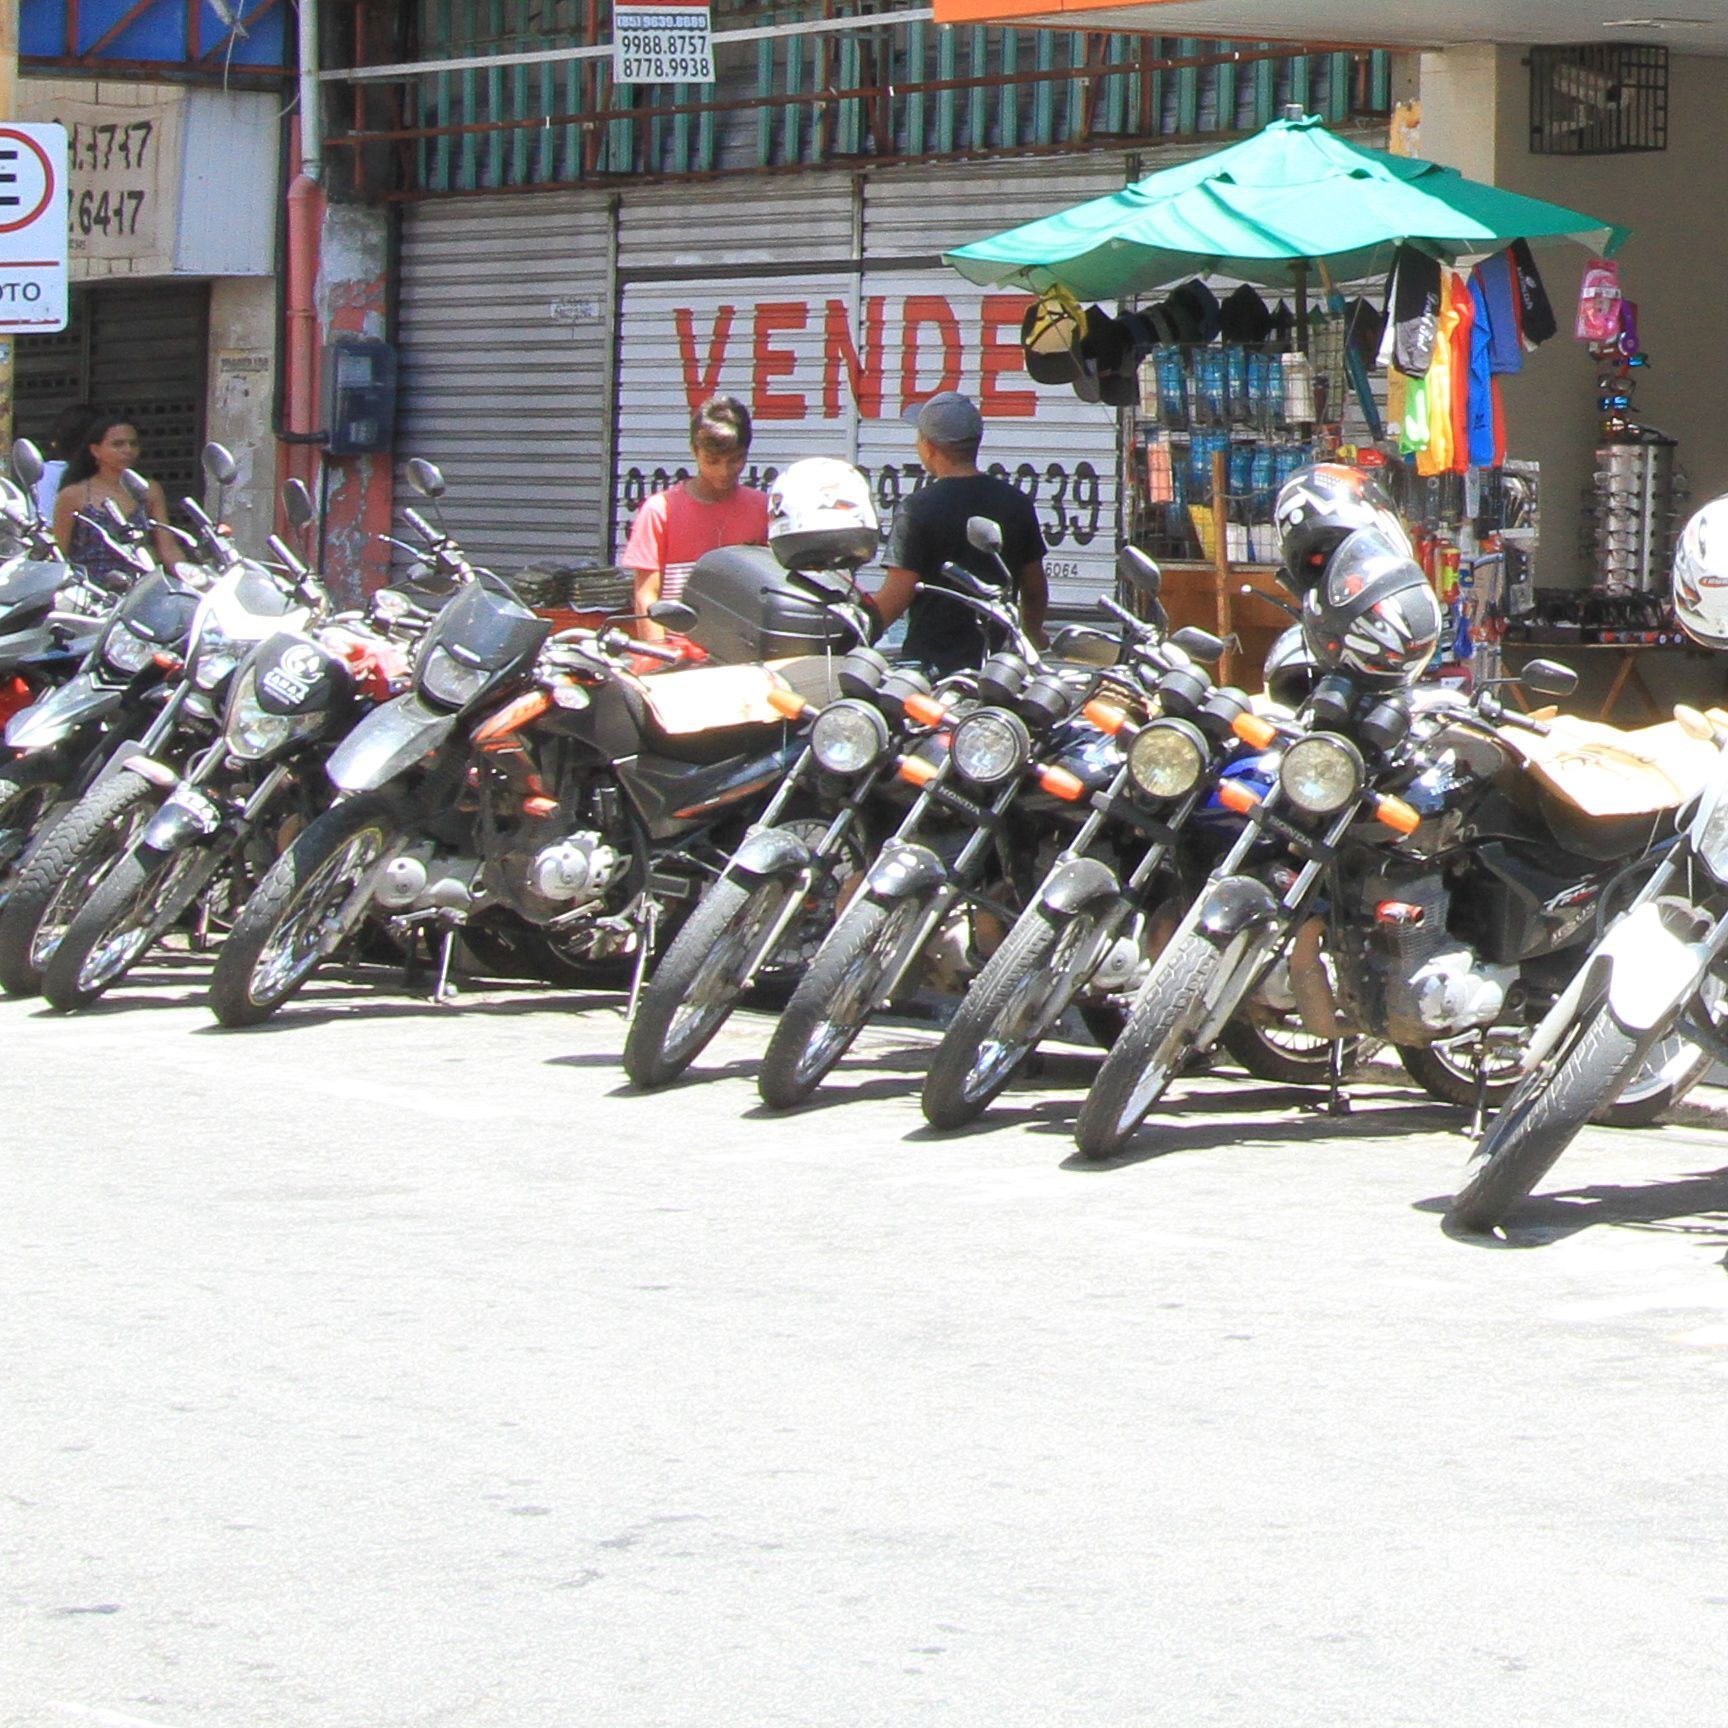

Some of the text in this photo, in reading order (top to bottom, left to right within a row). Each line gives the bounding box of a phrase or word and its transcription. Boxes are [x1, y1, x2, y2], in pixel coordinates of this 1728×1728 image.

[622, 35, 707, 55] 9988.8757
[624, 57, 710, 78] 8778.9938
[0, 281, 42, 303] TO
[673, 294, 1038, 420] VENDE
[1430, 775, 1475, 797] HONDA
[938, 786, 980, 815] HONDA
